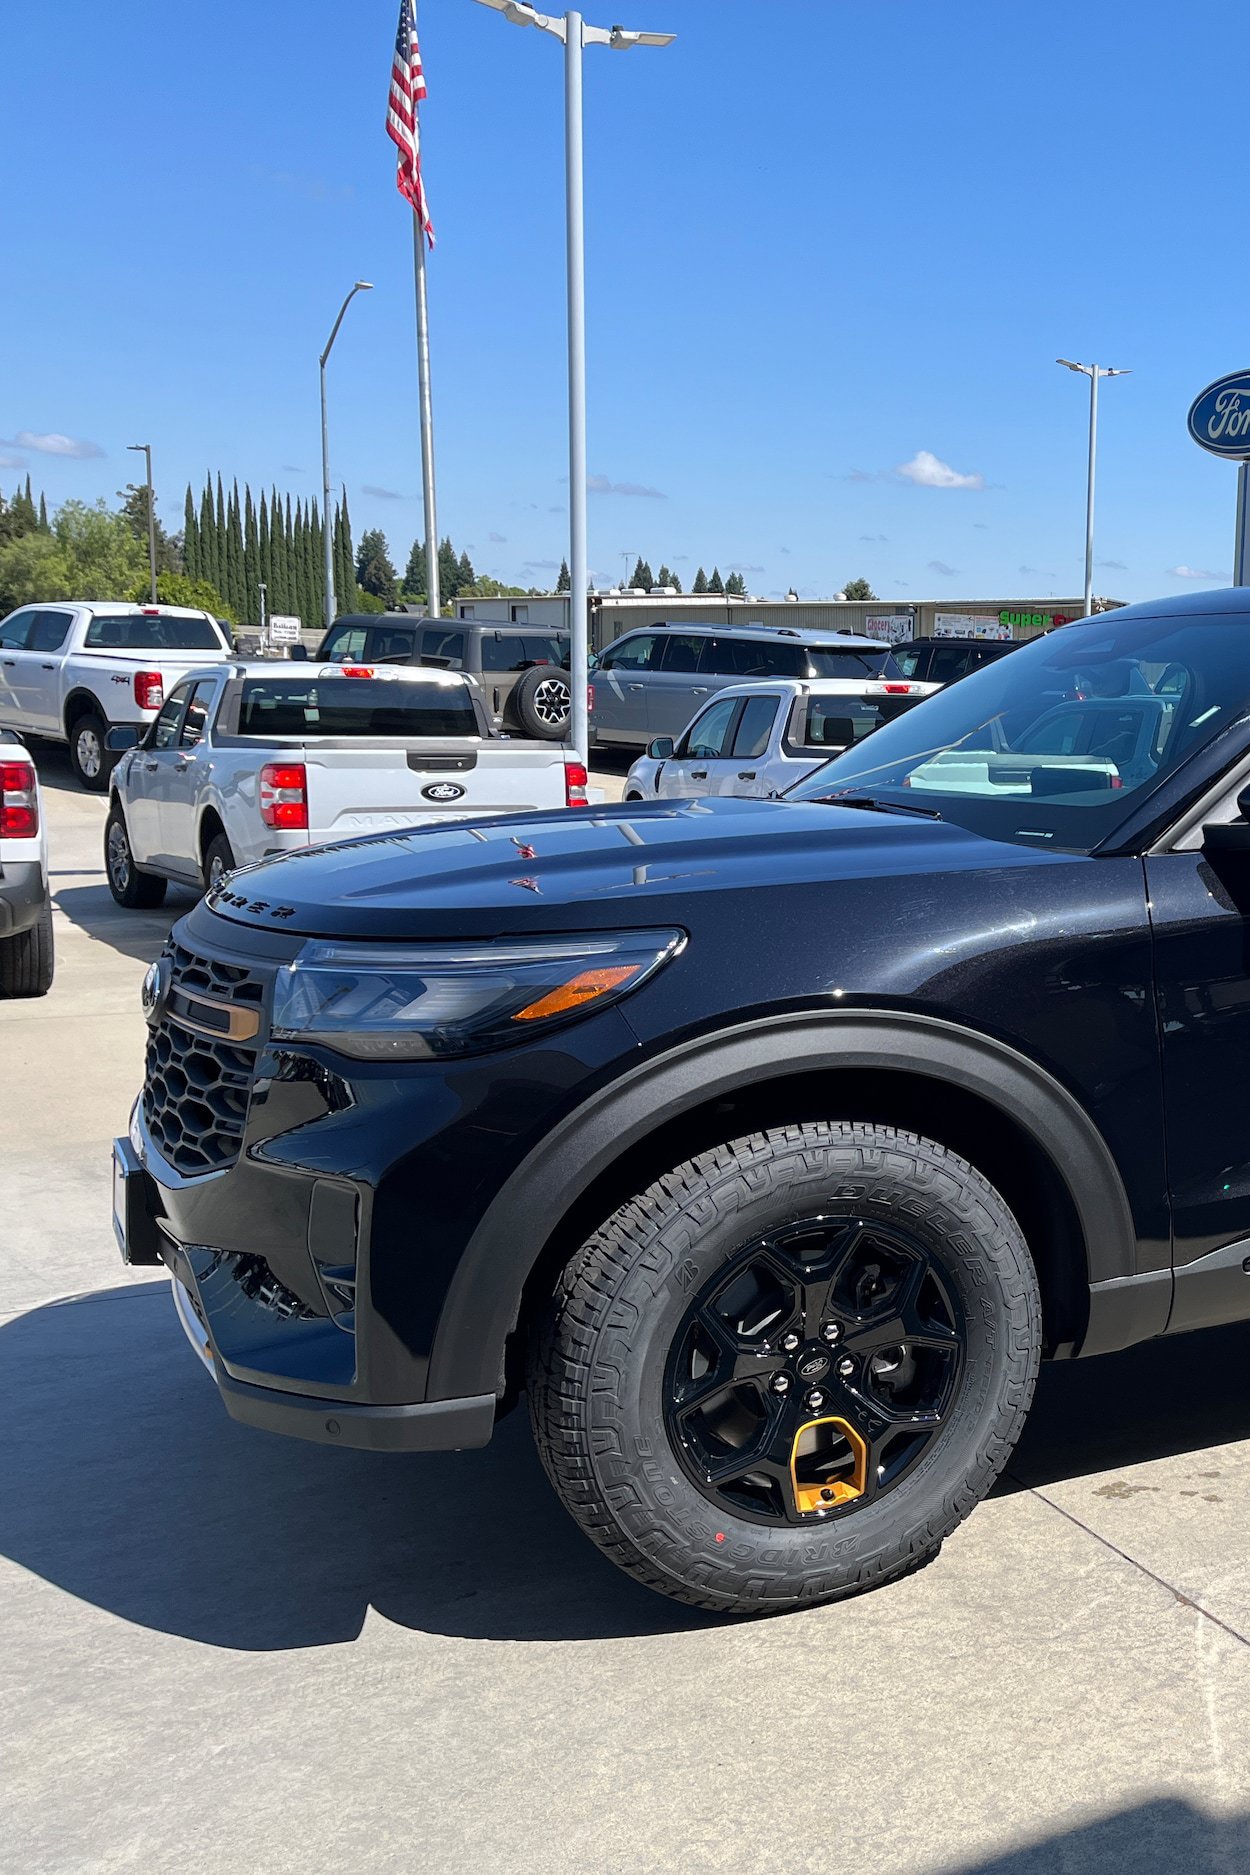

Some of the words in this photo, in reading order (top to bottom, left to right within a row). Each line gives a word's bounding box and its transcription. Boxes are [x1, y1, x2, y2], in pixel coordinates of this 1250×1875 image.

[999, 610, 1051, 628] Super
[830, 1184, 988, 1287] DUELER
[633, 1433, 861, 1568] BRIDGESTONE
